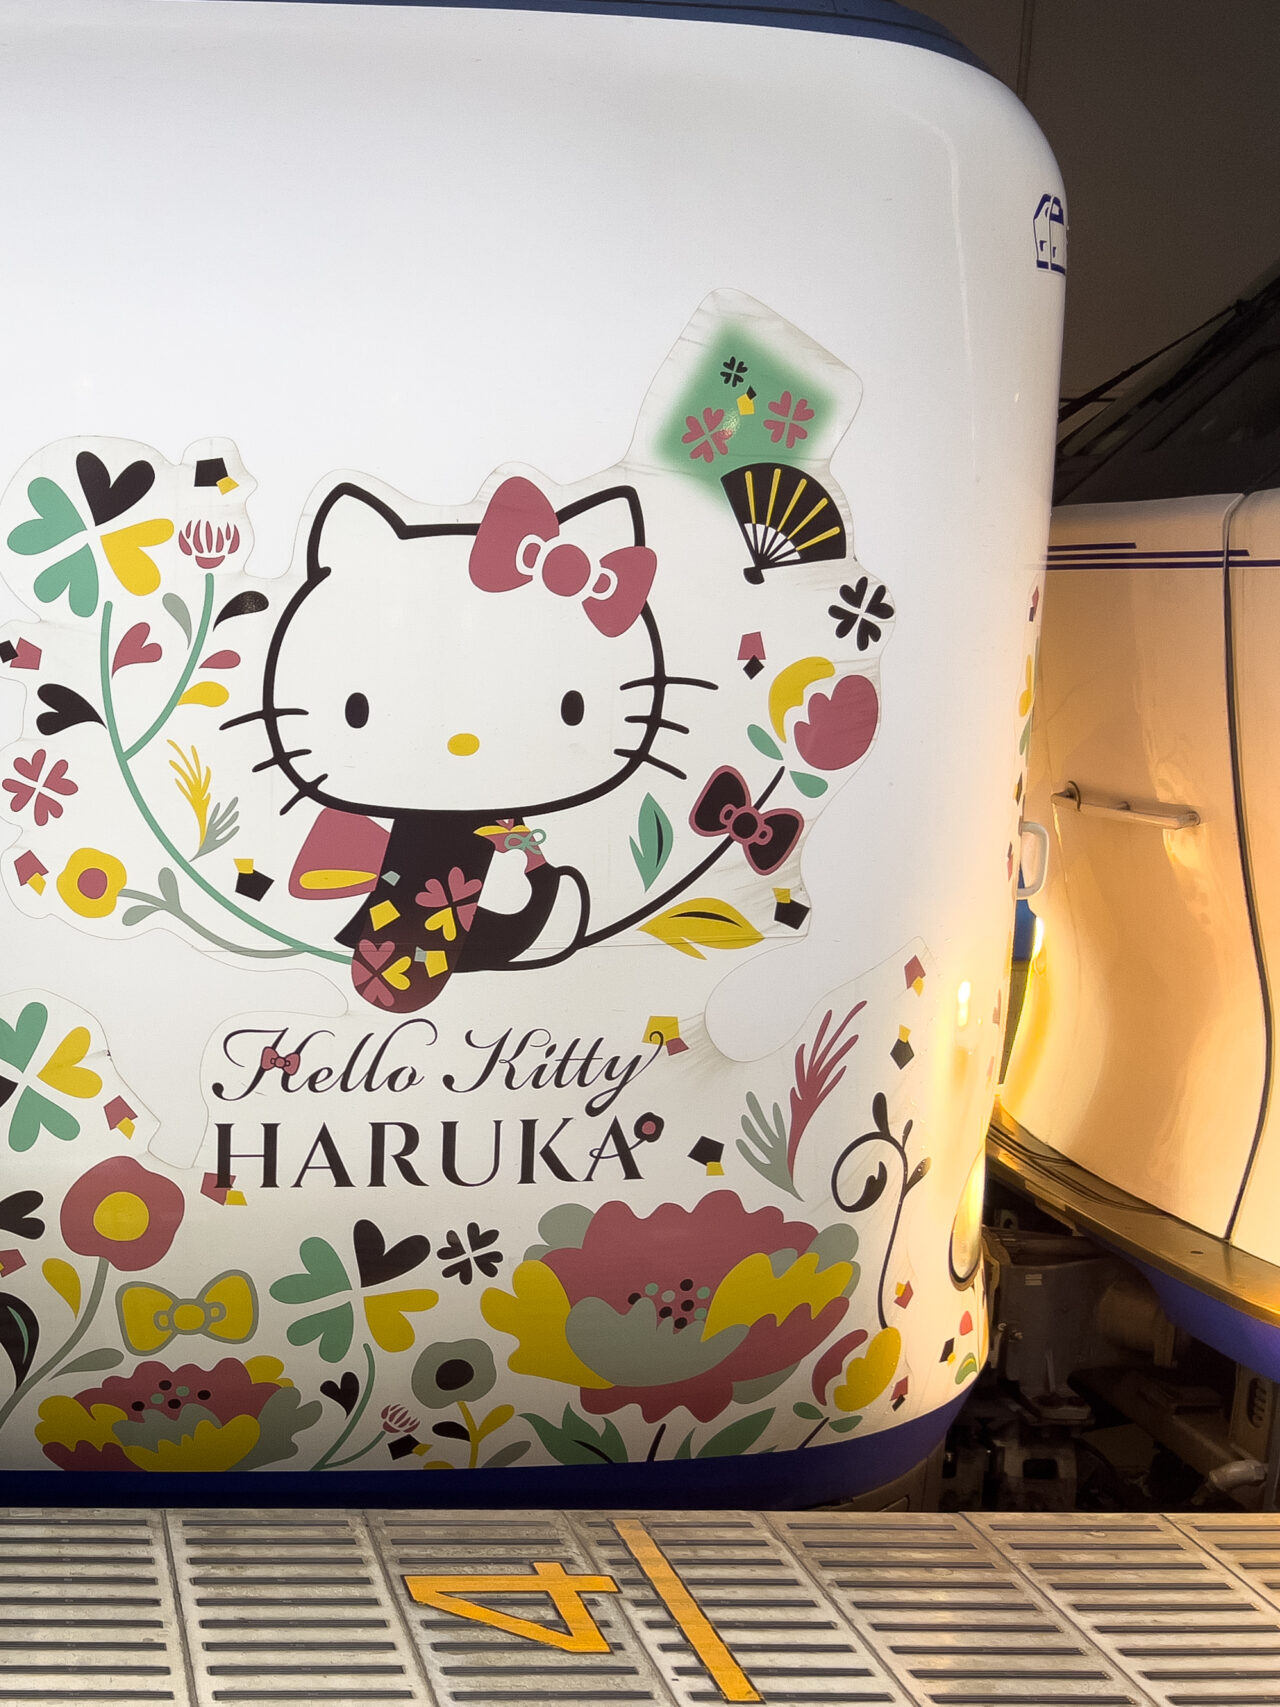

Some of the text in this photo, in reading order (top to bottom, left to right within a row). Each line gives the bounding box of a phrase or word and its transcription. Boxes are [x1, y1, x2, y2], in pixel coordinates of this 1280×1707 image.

[211, 1018, 665, 1118] Hello Kitty
[213, 1112, 664, 1189] HARUKA
